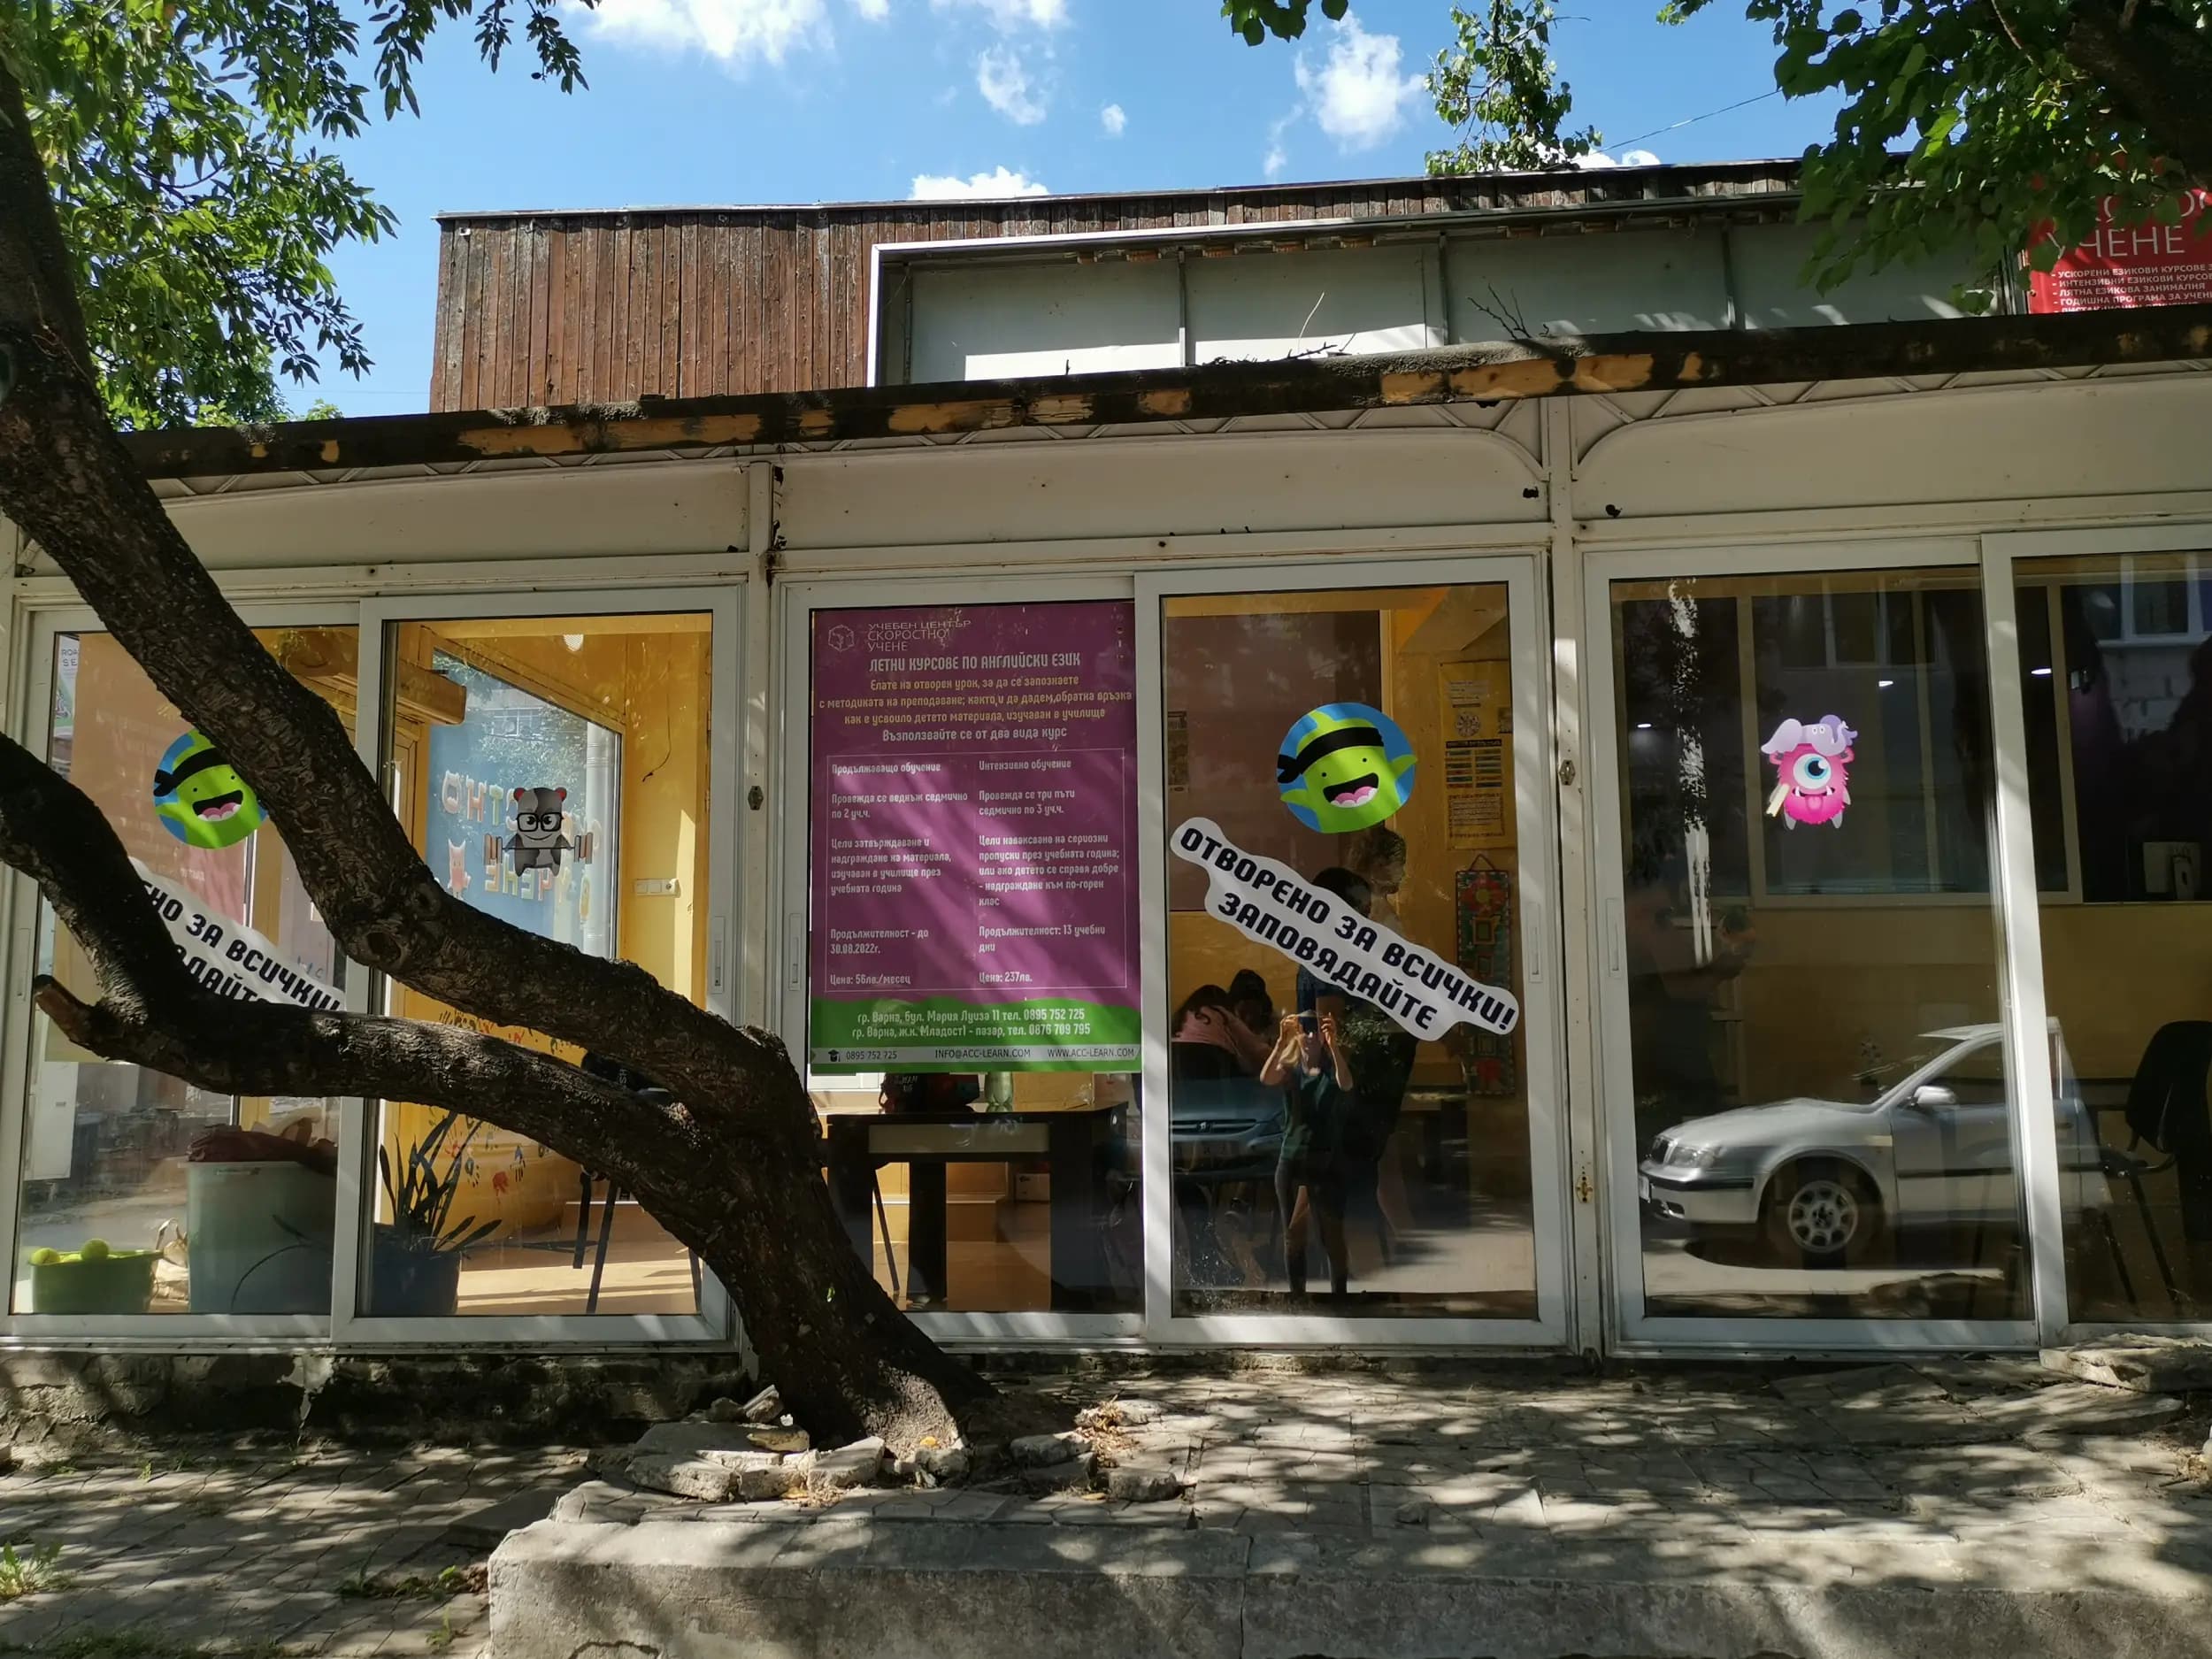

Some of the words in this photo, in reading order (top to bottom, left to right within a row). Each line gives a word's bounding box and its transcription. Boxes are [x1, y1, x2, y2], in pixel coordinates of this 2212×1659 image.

[2057, 269, 2109, 278] УСКОРЕНИ
[2111, 266, 2158, 275] ЕЗИКОВИ
[2059, 279, 2124, 288] ИНТЕНЗИВНИ
[2059, 288, 2093, 297] ЛЯТНА
[2095, 285, 2140, 296] ЕЗИКОВА
[2143, 283, 2206, 293] ЗАНИМАЛНЯ
[2060, 296, 2109, 306] ГОДИШНА
[2112, 294, 2166, 304] ПРОГРАМА
[920, 620, 972, 630] ЦЕНТЪР
[867, 629, 948, 641] СКОРОСТНО
[867, 641, 908, 651] УЧЕНЕ
[869, 657, 904, 672] ЛЕТНИ
[909, 657, 958, 670] КУРСОВЕ
[962, 656, 977, 669] ПО
[980, 651, 1048, 668] АНГЛИЙСКИ
[1051, 652, 1081, 666] ЕЗИК
[870, 679, 897, 690] Елате
[900, 680, 911, 689] на
[913, 680, 952, 691] отворен
[955, 679, 979, 690] урок,
[982, 679, 993, 687] за
[995, 679, 1008, 688] да
[1010, 677, 1022, 687] се
[1024, 676, 1079, 687] запознаете
[827, 698, 884, 709] методиката
[1005, 695, 1018, 704] да
[1056, 691, 1094, 704] обратна
[1097, 691, 1133, 703] връзка
[844, 715, 861, 724] как
[872, 714, 911, 726] усвоило
[913, 713, 947, 724] детето
[949, 712, 1004, 724] материала,
[1006, 709, 1050, 722] изучаван
[1062, 708, 1105, 721] училище
[882, 728, 956, 741] Възползвайте
[959, 730, 972, 739] се
[975, 730, 987, 739] от
[989, 729, 1010, 741] два
[1012, 728, 1038, 740] вида
[1041, 727, 1067, 740] курс
[832, 763, 898, 776] Продължаващо
[900, 761, 941, 775] обучение
[979, 759, 1029, 772] Интензивно
[1031, 758, 1071, 772] обучение
[832, 792, 875, 805] Провежда
[888, 794, 923, 803] веднъж
[925, 793, 968, 803] седмично
[979, 789, 1023, 803] Провежда
[1037, 791, 1052, 801] три
[979, 806, 1022, 816] седмично
[831, 838, 852, 849] Цели
[854, 839, 922, 850] затвърждаване
[979, 834, 1001, 846] Цели
[1067, 834, 1109, 845] сериозни
[831, 855, 887, 865] надграждане
[902, 853, 952, 864] материала,
[979, 851, 1019, 863] пропуски
[1022, 851, 1042, 863] през
[1044, 848, 1084, 861] учебната
[831, 870, 870, 880] изучаван
[879, 866, 918, 879] училище
[920, 868, 941, 879] през
[979, 867, 995, 876] или
[1014, 864, 1044, 876] детето
[1058, 865, 1089, 876] справя
[1091, 863, 1119, 875] добре
[831, 882, 870, 895] учебната
[872, 884, 902, 894] година
[985, 881, 1042, 892] надграждане
[1065, 878, 1104, 891] по-горен
[979, 897, 1000, 906] клас
[186, 914, 224, 949] ЗА
[830, 927, 909, 941] Продължителност
[917, 929, 929, 939] до
[979, 926, 1061, 939] Продължителност:
[1063, 924, 1071, 934] 13
[1074, 924, 1106, 937] учебни
[1180, 827, 1330, 924] ОТВОРЕНО
[1334, 915, 1378, 952] ЗА
[1383, 942, 1516, 1030] ВСИЧКИ!
[979, 943, 996, 953] дни
[1217, 892, 1438, 1030] ЗАПОВЯДАЙТЕ
[830, 974, 853, 985] Цена:
[979, 972, 1002, 983] Цена:
[1004, 971, 1033, 982] 237лв.
[857, 1014, 870, 1025] гр.
[872, 1011, 902, 1025] Варна,
[904, 1010, 924, 1025] бул.
[926, 1010, 958, 1025] Мария
[960, 1010, 989, 1024] Луиза
[1002, 1011, 1021, 1020] тел.
[1023, 1008, 1047, 1020] 0895
[1048, 1008, 1066, 1019] 752
[1068, 1008, 1086, 1019] 725
[852, 1028, 864, 1040] гр.
[866, 1025, 896, 1039] Варна,
[920, 1025, 965, 1037] Младост1
[975, 1026, 1005, 1038] пазар,
[1007, 1026, 1026, 1035] тел.
[1028, 1023, 1051, 1035] 0876
[1054, 1023, 1071, 1035] 709
[1073, 1023, 1091, 1034] 795
[846, 1050, 864, 1060] 0895
[867, 1050, 880, 1059] 752
[883, 1050, 897, 1059] 725
[934, 1048, 1031, 1058] INFO@ACC-LEARN.COM
[1047, 1048, 1135, 1057] WWW.ACC-LEARN.COM
